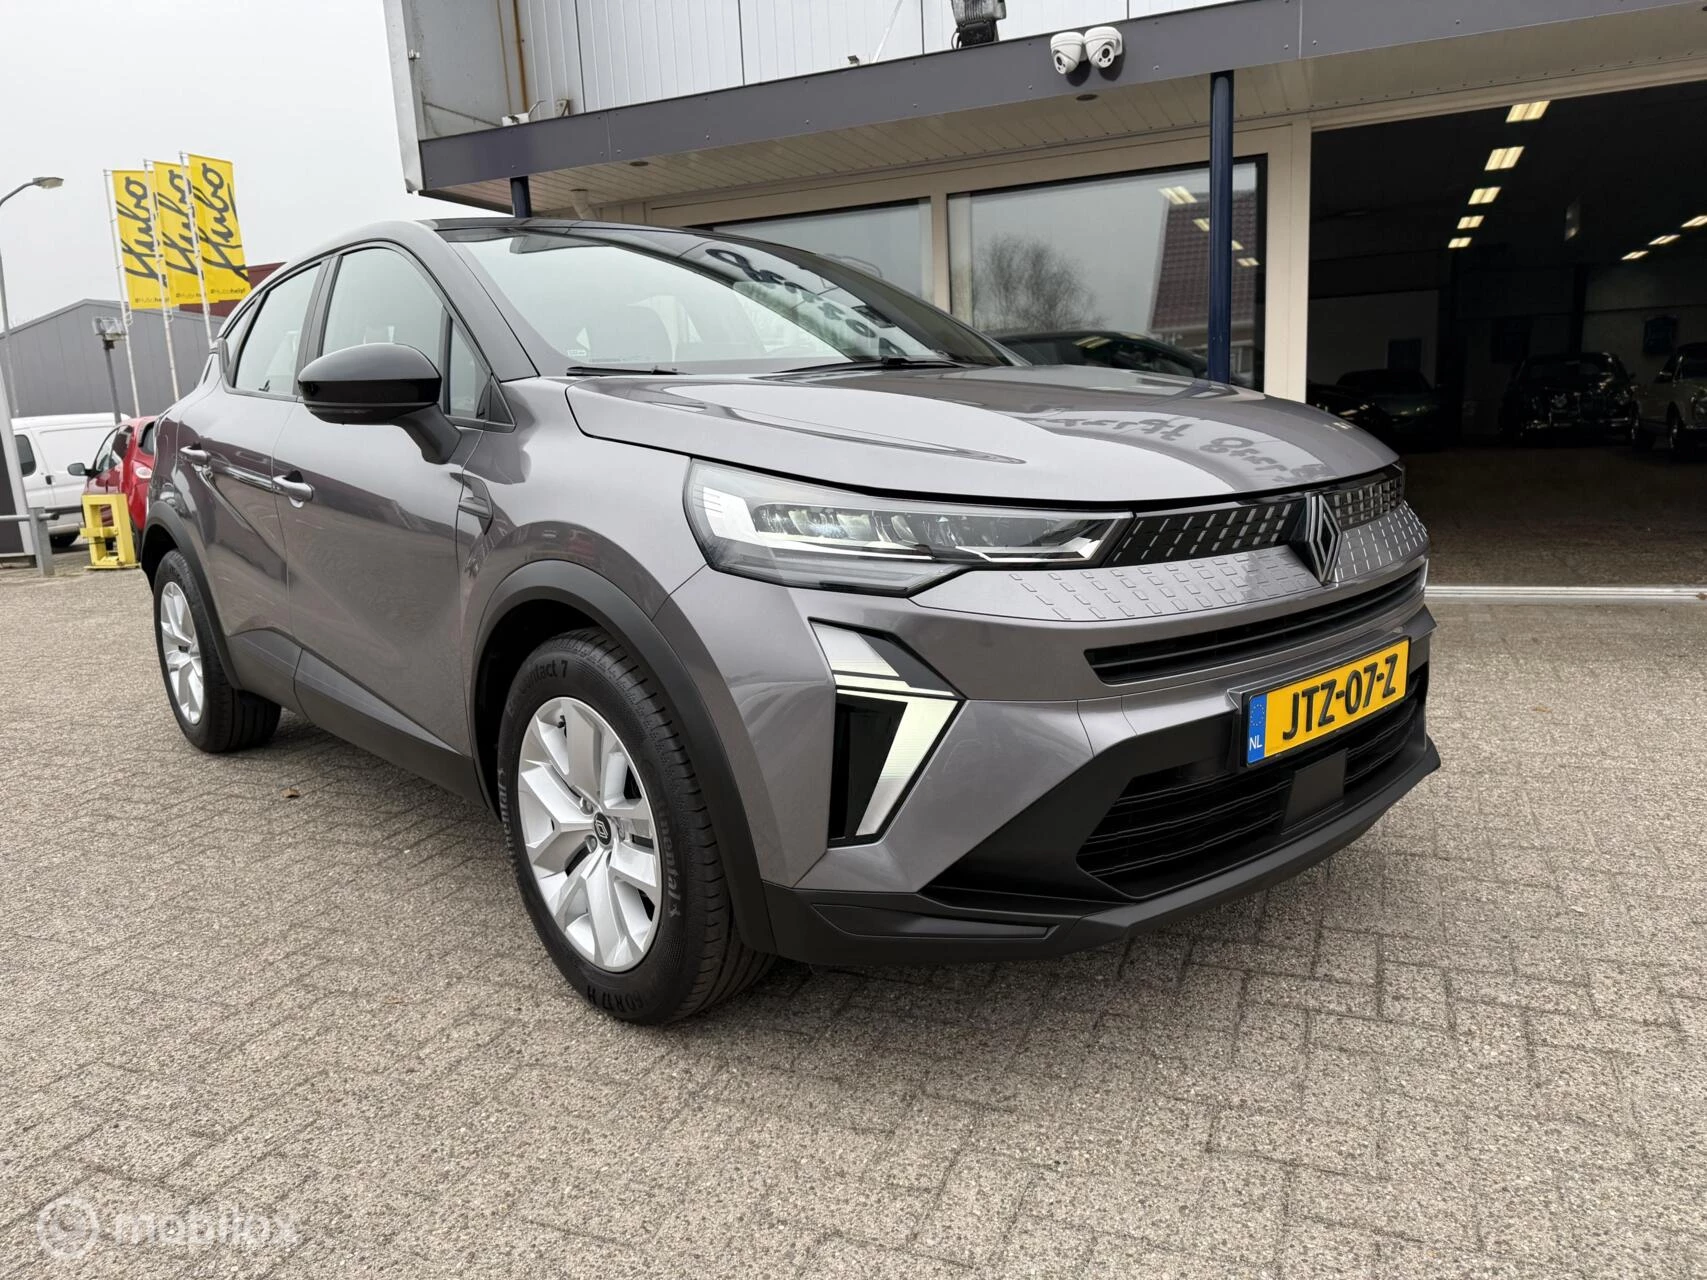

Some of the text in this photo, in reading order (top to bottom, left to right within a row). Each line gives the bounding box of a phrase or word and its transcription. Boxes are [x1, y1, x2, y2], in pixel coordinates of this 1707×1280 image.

[192, 162, 249, 282] Hubo
[561, 660, 568, 678] 7
[1282, 653, 1398, 740] JTZ-07-Z
[1249, 734, 1262, 751] NL
